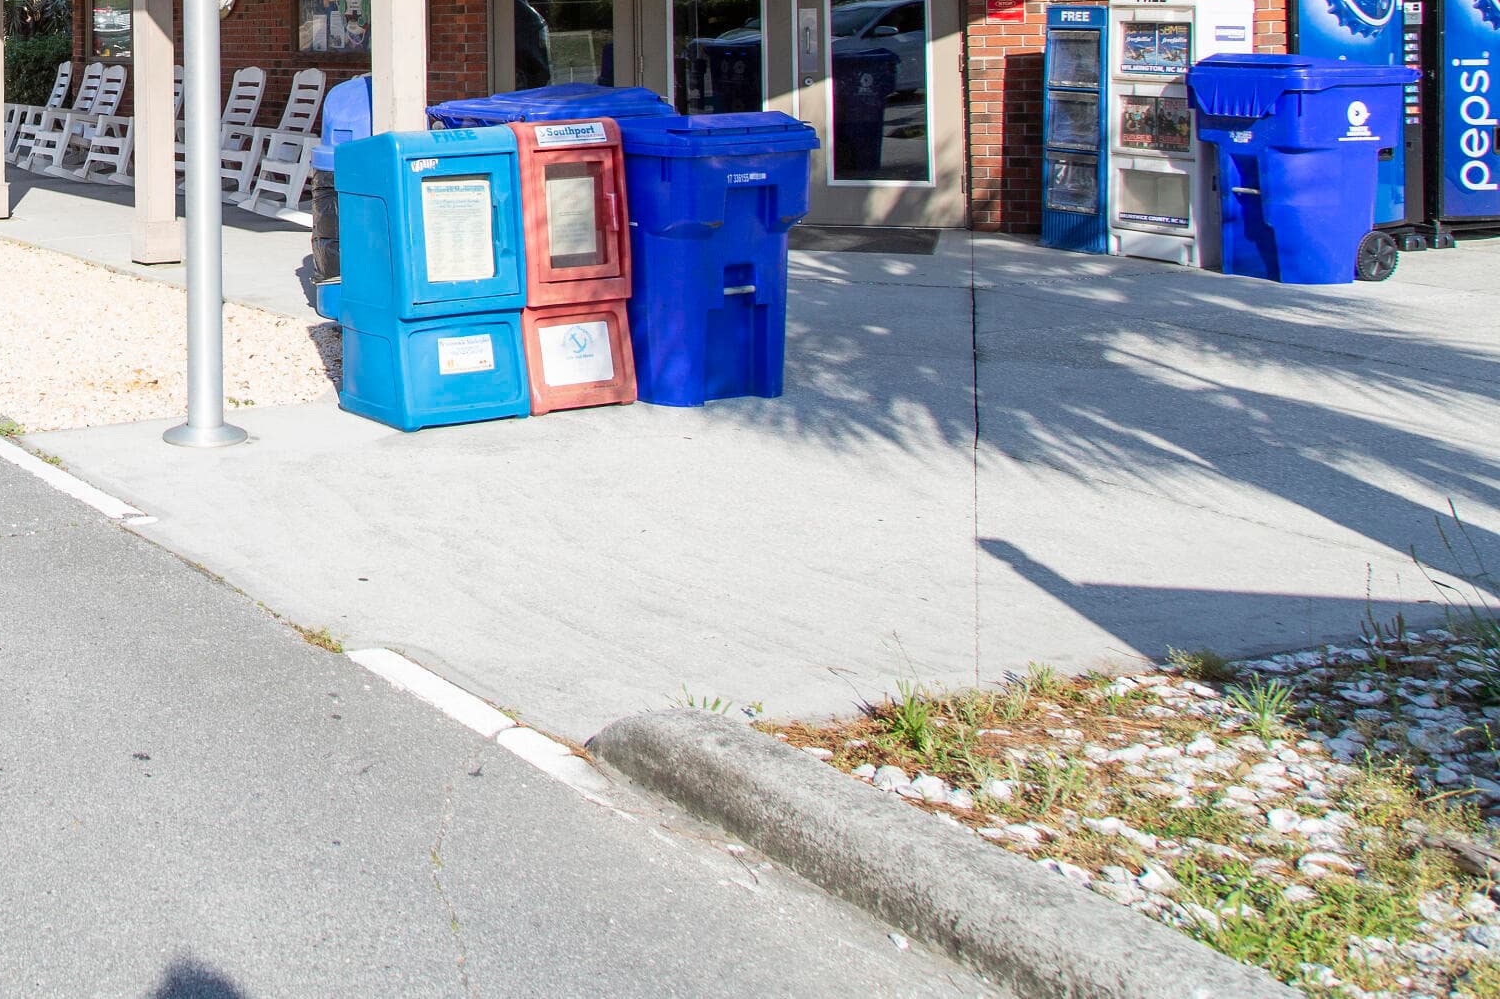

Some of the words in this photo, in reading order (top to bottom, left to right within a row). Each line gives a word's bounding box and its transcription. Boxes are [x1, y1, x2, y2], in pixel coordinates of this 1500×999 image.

[1061, 11, 1091, 22] FREE
[1452, 57, 1498, 191] pepsi
[430, 129, 478, 143] FREE
[546, 125, 595, 138] Southport
